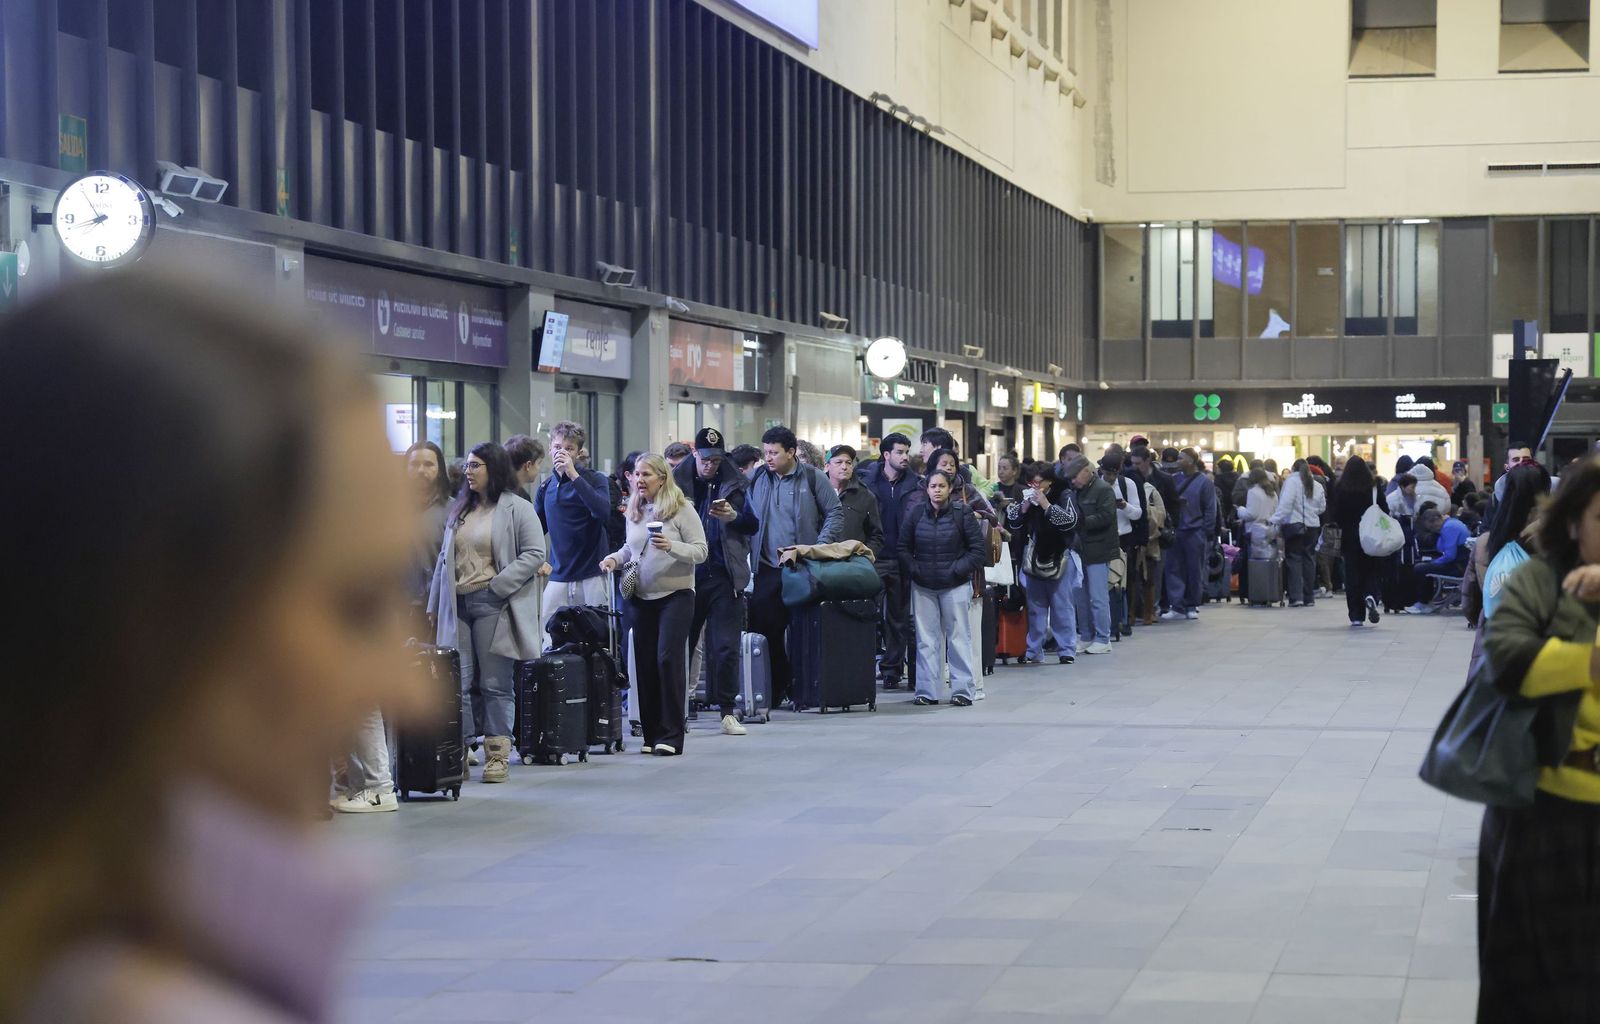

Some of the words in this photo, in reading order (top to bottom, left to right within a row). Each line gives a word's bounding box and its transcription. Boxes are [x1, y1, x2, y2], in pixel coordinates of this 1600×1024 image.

[59, 132, 85, 158] SALIDA
[94, 183, 110, 194] 12
[64, 213, 75, 224] 9
[127, 215, 138, 226] 3
[95, 245, 107, 257] 6
[1395, 393, 1416, 403] café
[1282, 402, 1333, 417] Deliquo
[1395, 402, 1446, 411] restaurante
[1395, 410, 1427, 418] terraza
